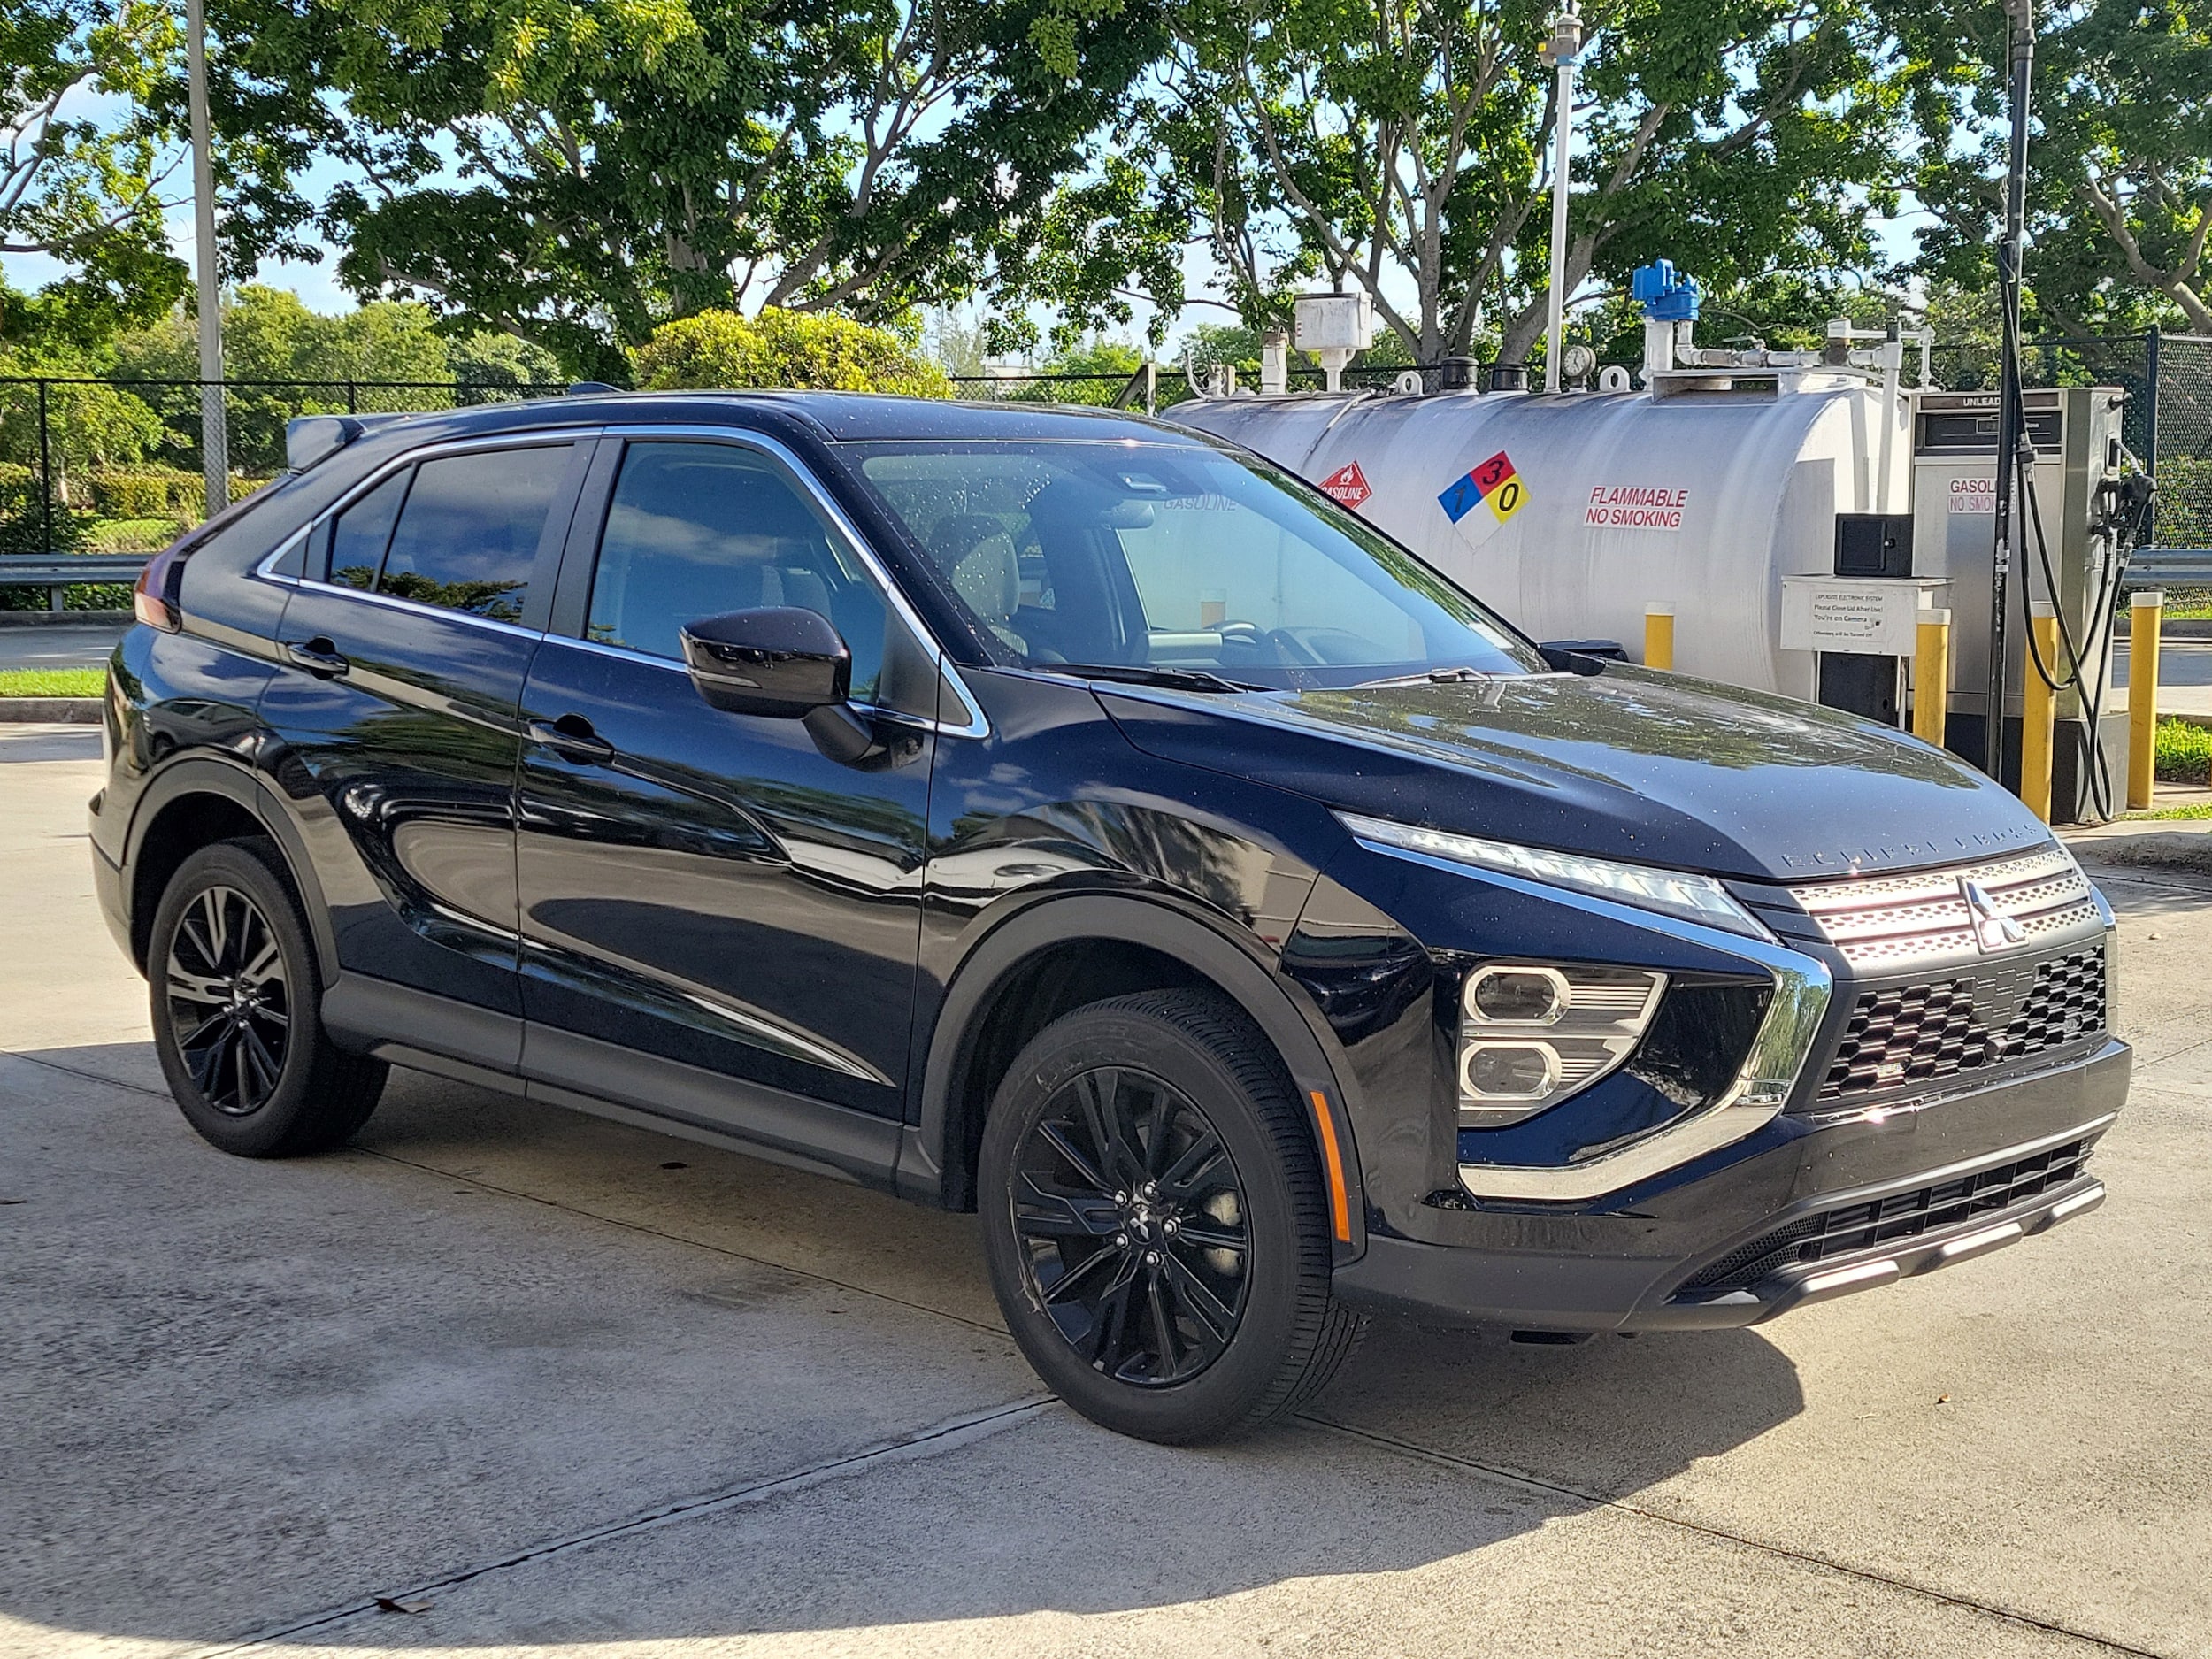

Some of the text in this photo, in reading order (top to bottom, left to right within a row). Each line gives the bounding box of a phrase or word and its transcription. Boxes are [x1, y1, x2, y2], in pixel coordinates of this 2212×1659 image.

[1963, 397, 2001, 406] UNLEAD
[1482, 460, 1504, 485] 3
[1950, 480, 2015, 493] GASOL
[1164, 494, 1238, 511] GASOLINE
[1455, 486, 1467, 513] 1
[1498, 483, 1520, 512] 0
[1589, 487, 1688, 508] FLAMMABLE
[1950, 496, 1964, 511] NO
[1586, 508, 1681, 527] NO SMOKING
